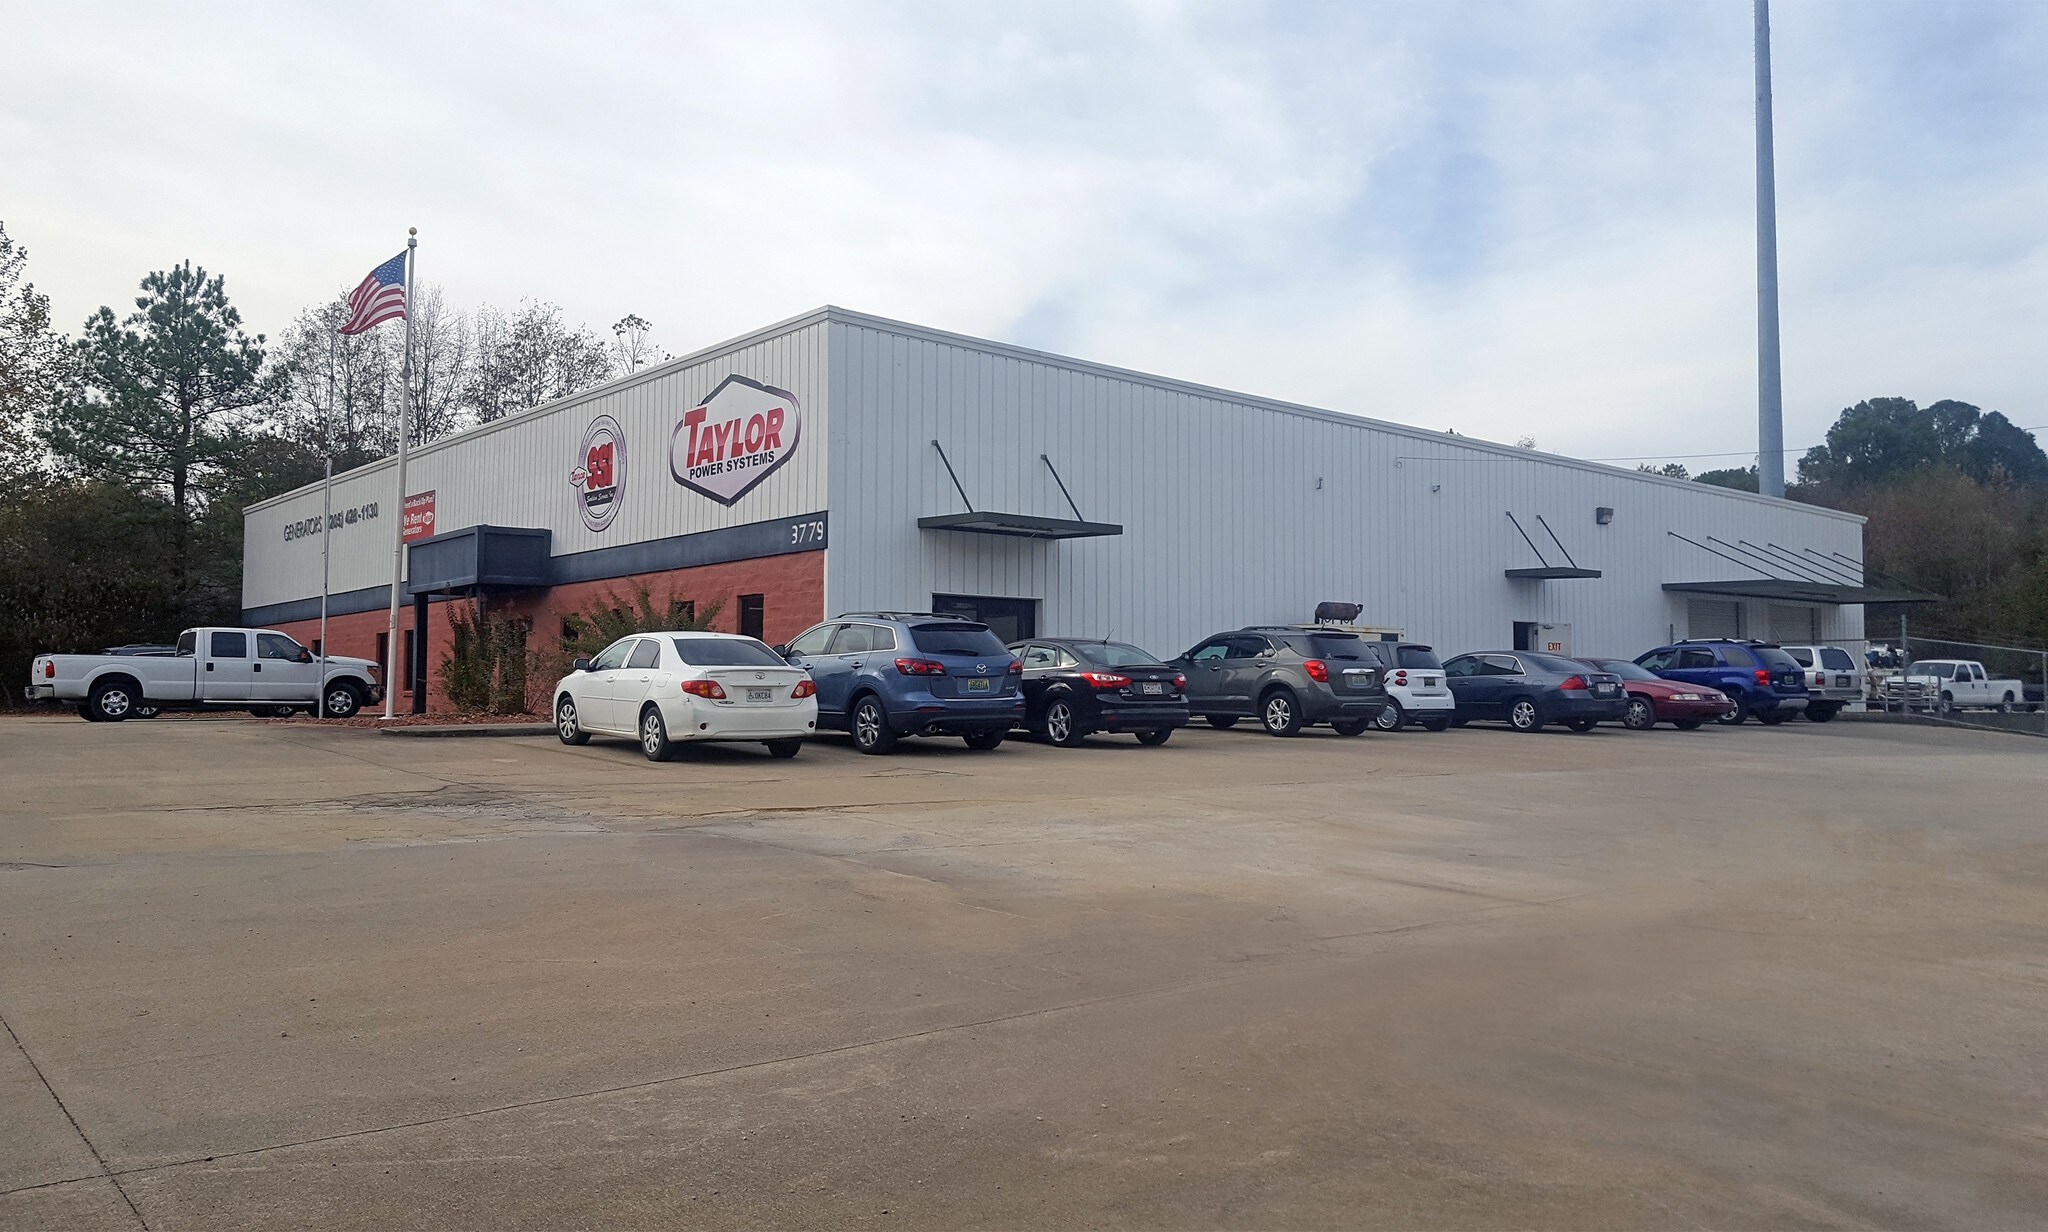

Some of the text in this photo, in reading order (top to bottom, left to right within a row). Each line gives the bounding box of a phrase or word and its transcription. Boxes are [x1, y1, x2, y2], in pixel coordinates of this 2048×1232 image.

[684, 406, 785, 468] TAYLOR
[587, 441, 613, 490] SSI
[689, 450, 775, 480] POWER SYSTEMS
[283, 515, 323, 542] GENERATORS
[411, 512, 422, 525] Rent
[791, 521, 824, 545] 3779
[1548, 642, 1561, 651] EXIT
